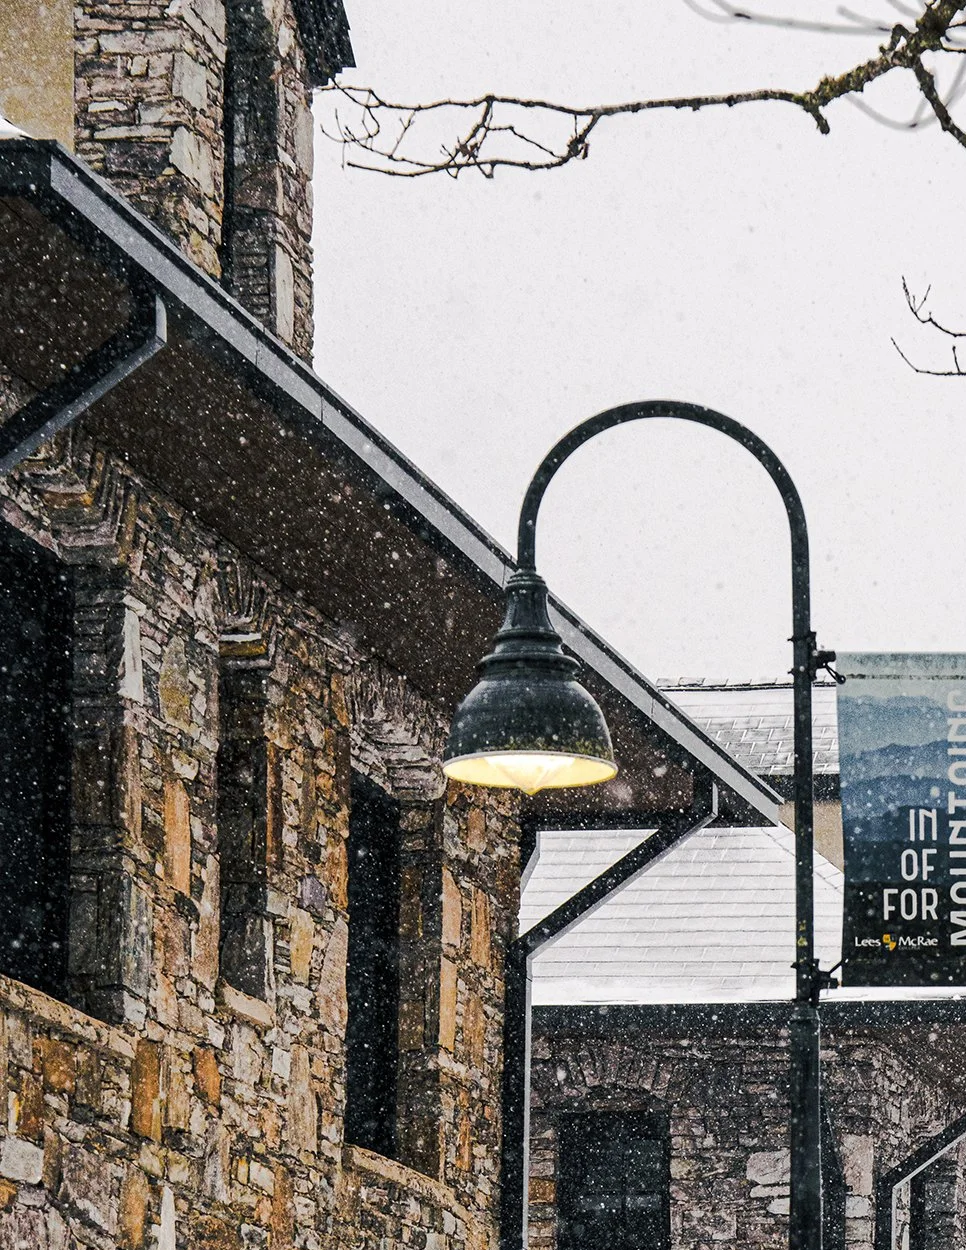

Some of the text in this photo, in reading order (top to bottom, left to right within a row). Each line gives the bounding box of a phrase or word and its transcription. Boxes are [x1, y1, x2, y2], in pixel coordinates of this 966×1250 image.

[909, 809, 937, 841] IN
[901, 849, 937, 881] OF
[884, 889, 938, 920] FOR
[854, 936, 939, 947] Lees McRae
